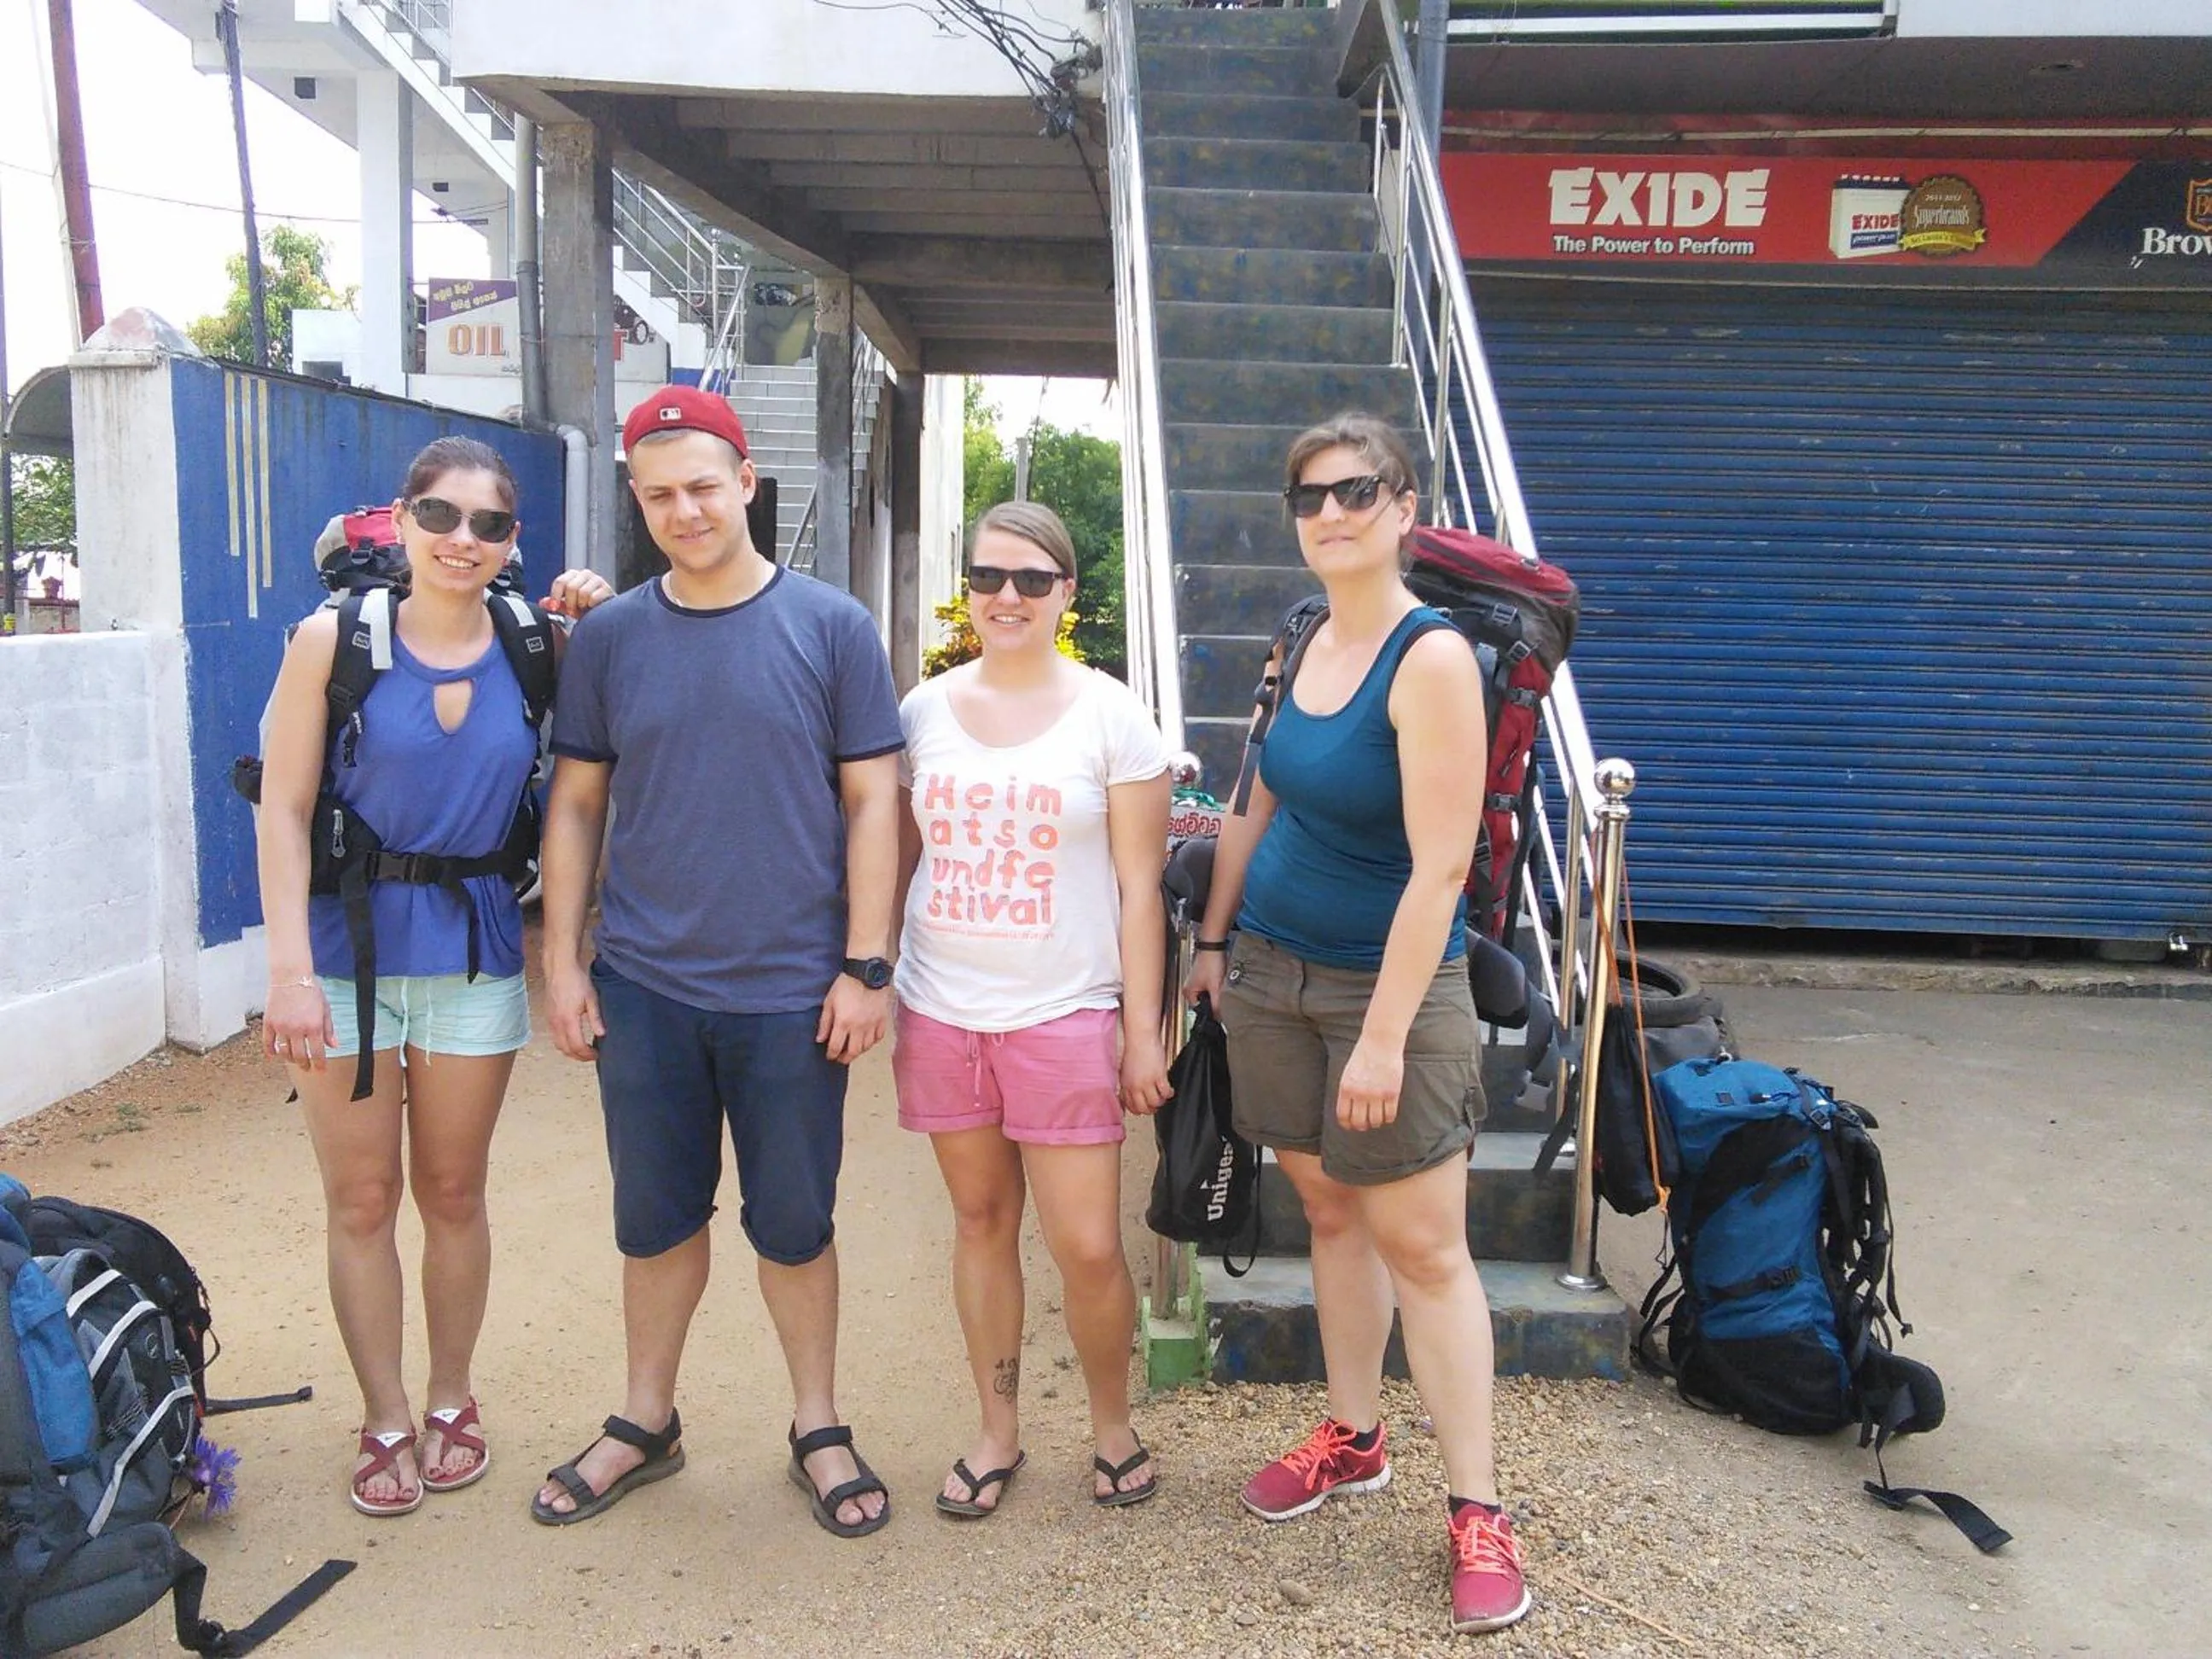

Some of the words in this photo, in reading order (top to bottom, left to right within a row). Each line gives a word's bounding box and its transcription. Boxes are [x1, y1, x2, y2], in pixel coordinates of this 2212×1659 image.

[1548, 167, 1770, 227] EXIDE
[1852, 213, 1900, 230] EXIDE
[1553, 235, 1586, 253] The
[1592, 236, 1650, 253] Power
[1654, 237, 1674, 254] to
[1679, 237, 1755, 255] Perform
[448, 323, 506, 357] OIL
[924, 773, 1062, 817] Heim
[928, 812, 1059, 851] atso
[931, 848, 1056, 891] undfe
[927, 884, 1052, 925] stival
